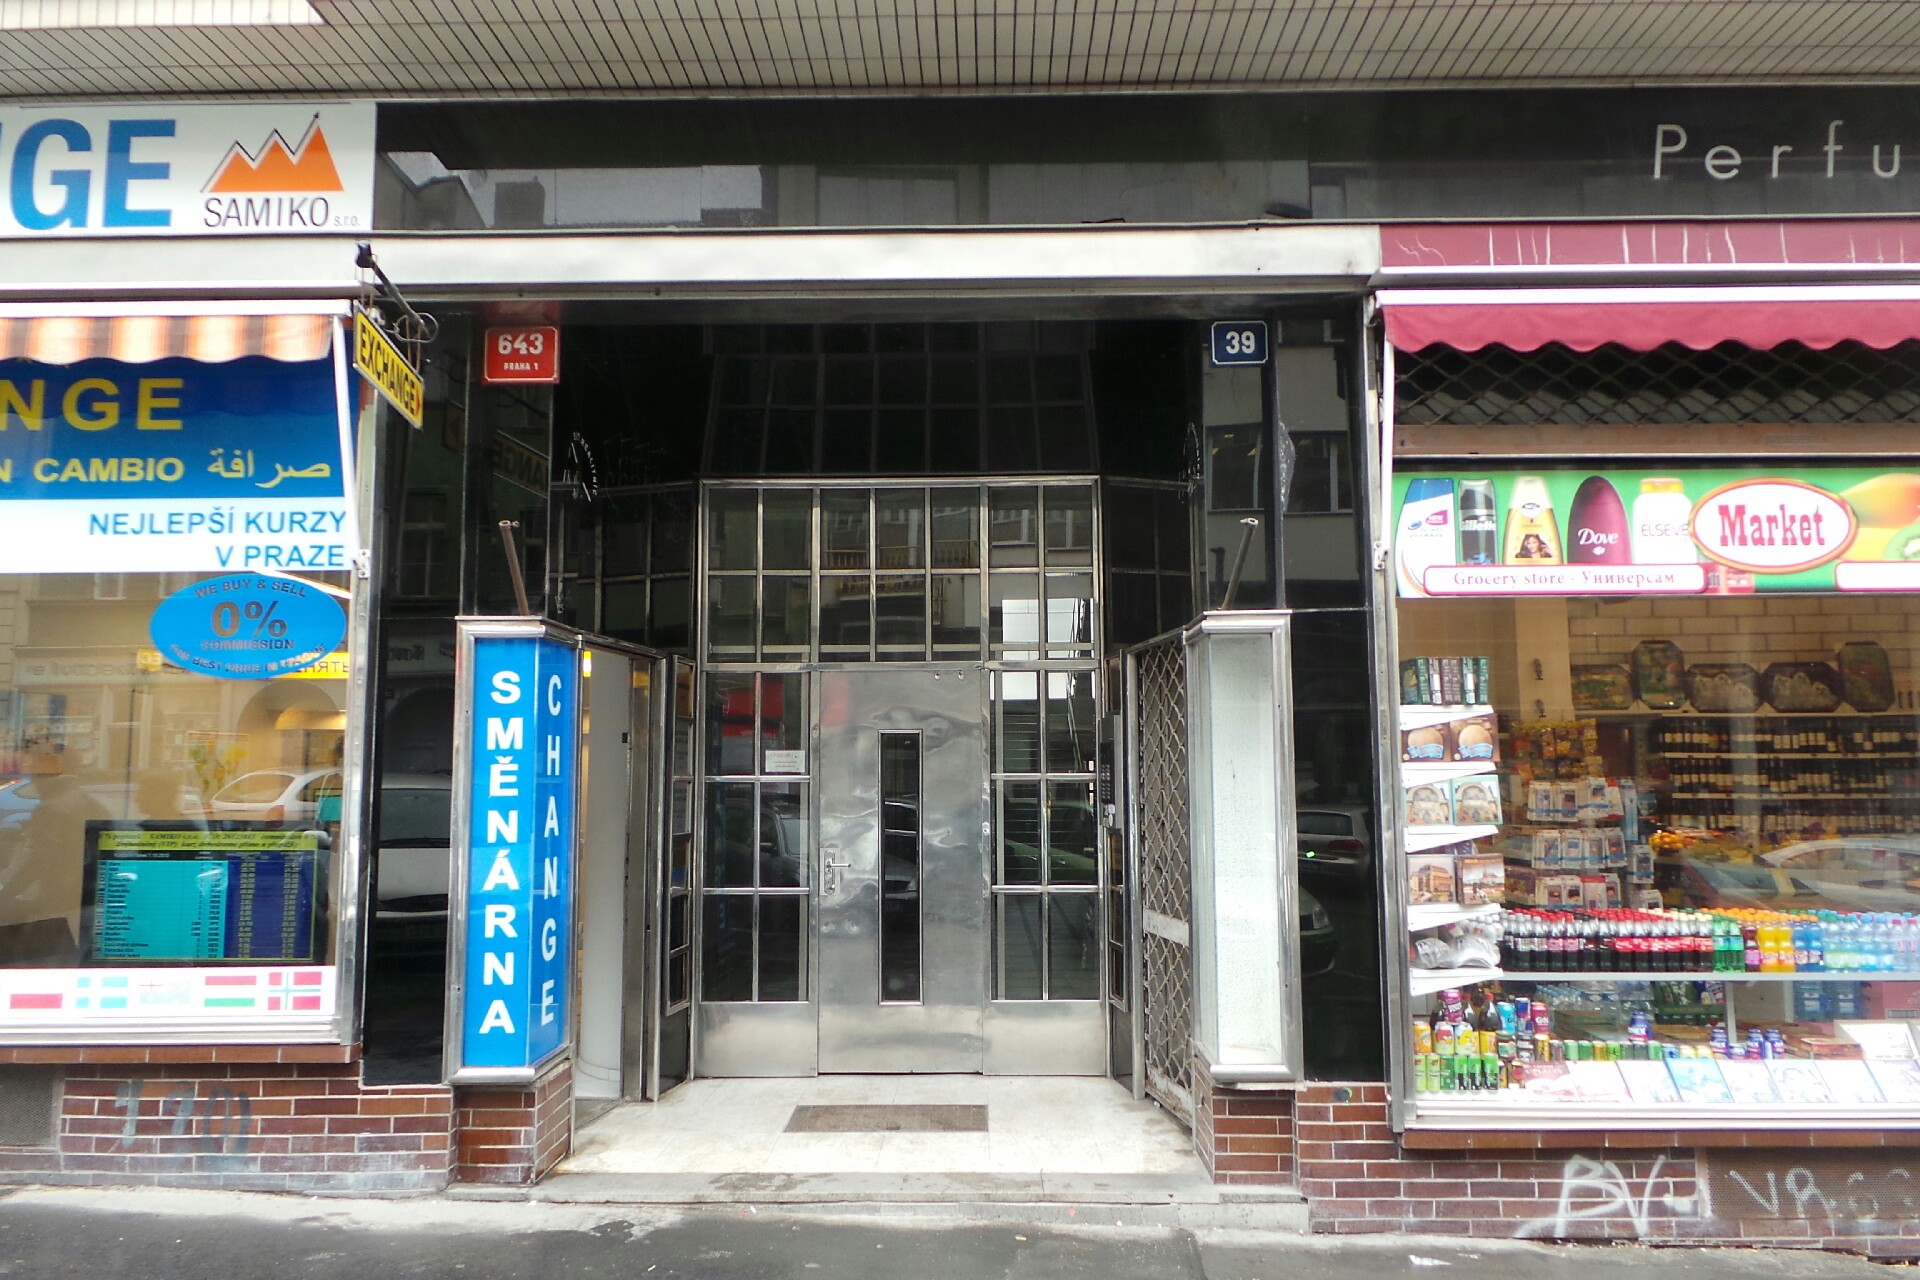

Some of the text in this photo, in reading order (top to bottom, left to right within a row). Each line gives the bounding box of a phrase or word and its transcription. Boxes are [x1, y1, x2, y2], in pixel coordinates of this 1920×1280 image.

[1653, 120, 1900, 180] Perfu
[0, 118, 176, 231] GE
[203, 197, 361, 227] SAMIKO s.r.o.
[498, 333, 544, 355] 643
[1225, 330, 1256, 354] 39
[360, 320, 416, 417] EXCHANGE
[503, 362, 539, 371] PRAHA 1
[33, 457, 185, 483] CAMBIO
[89, 506, 347, 536] NEJLEPŠÍ KURZY
[1718, 504, 1826, 546] Market
[1578, 528, 1619, 545] Dove
[215, 545, 345, 568] V PRAZE
[194, 579, 306, 598] WE BUY & SELL
[1453, 571, 1518, 588] Grocery
[1524, 573, 1565, 584] store
[1582, 570, 1675, 588] Универсам
[211, 600, 288, 637] 0%
[201, 639, 295, 650] COMMISSION
[192, 658, 223, 671] BEST
[226, 664, 261, 673] PRICE
[479, 670, 523, 1035] SMĚNÁRNA
[540, 674, 562, 1027] CHANGE
